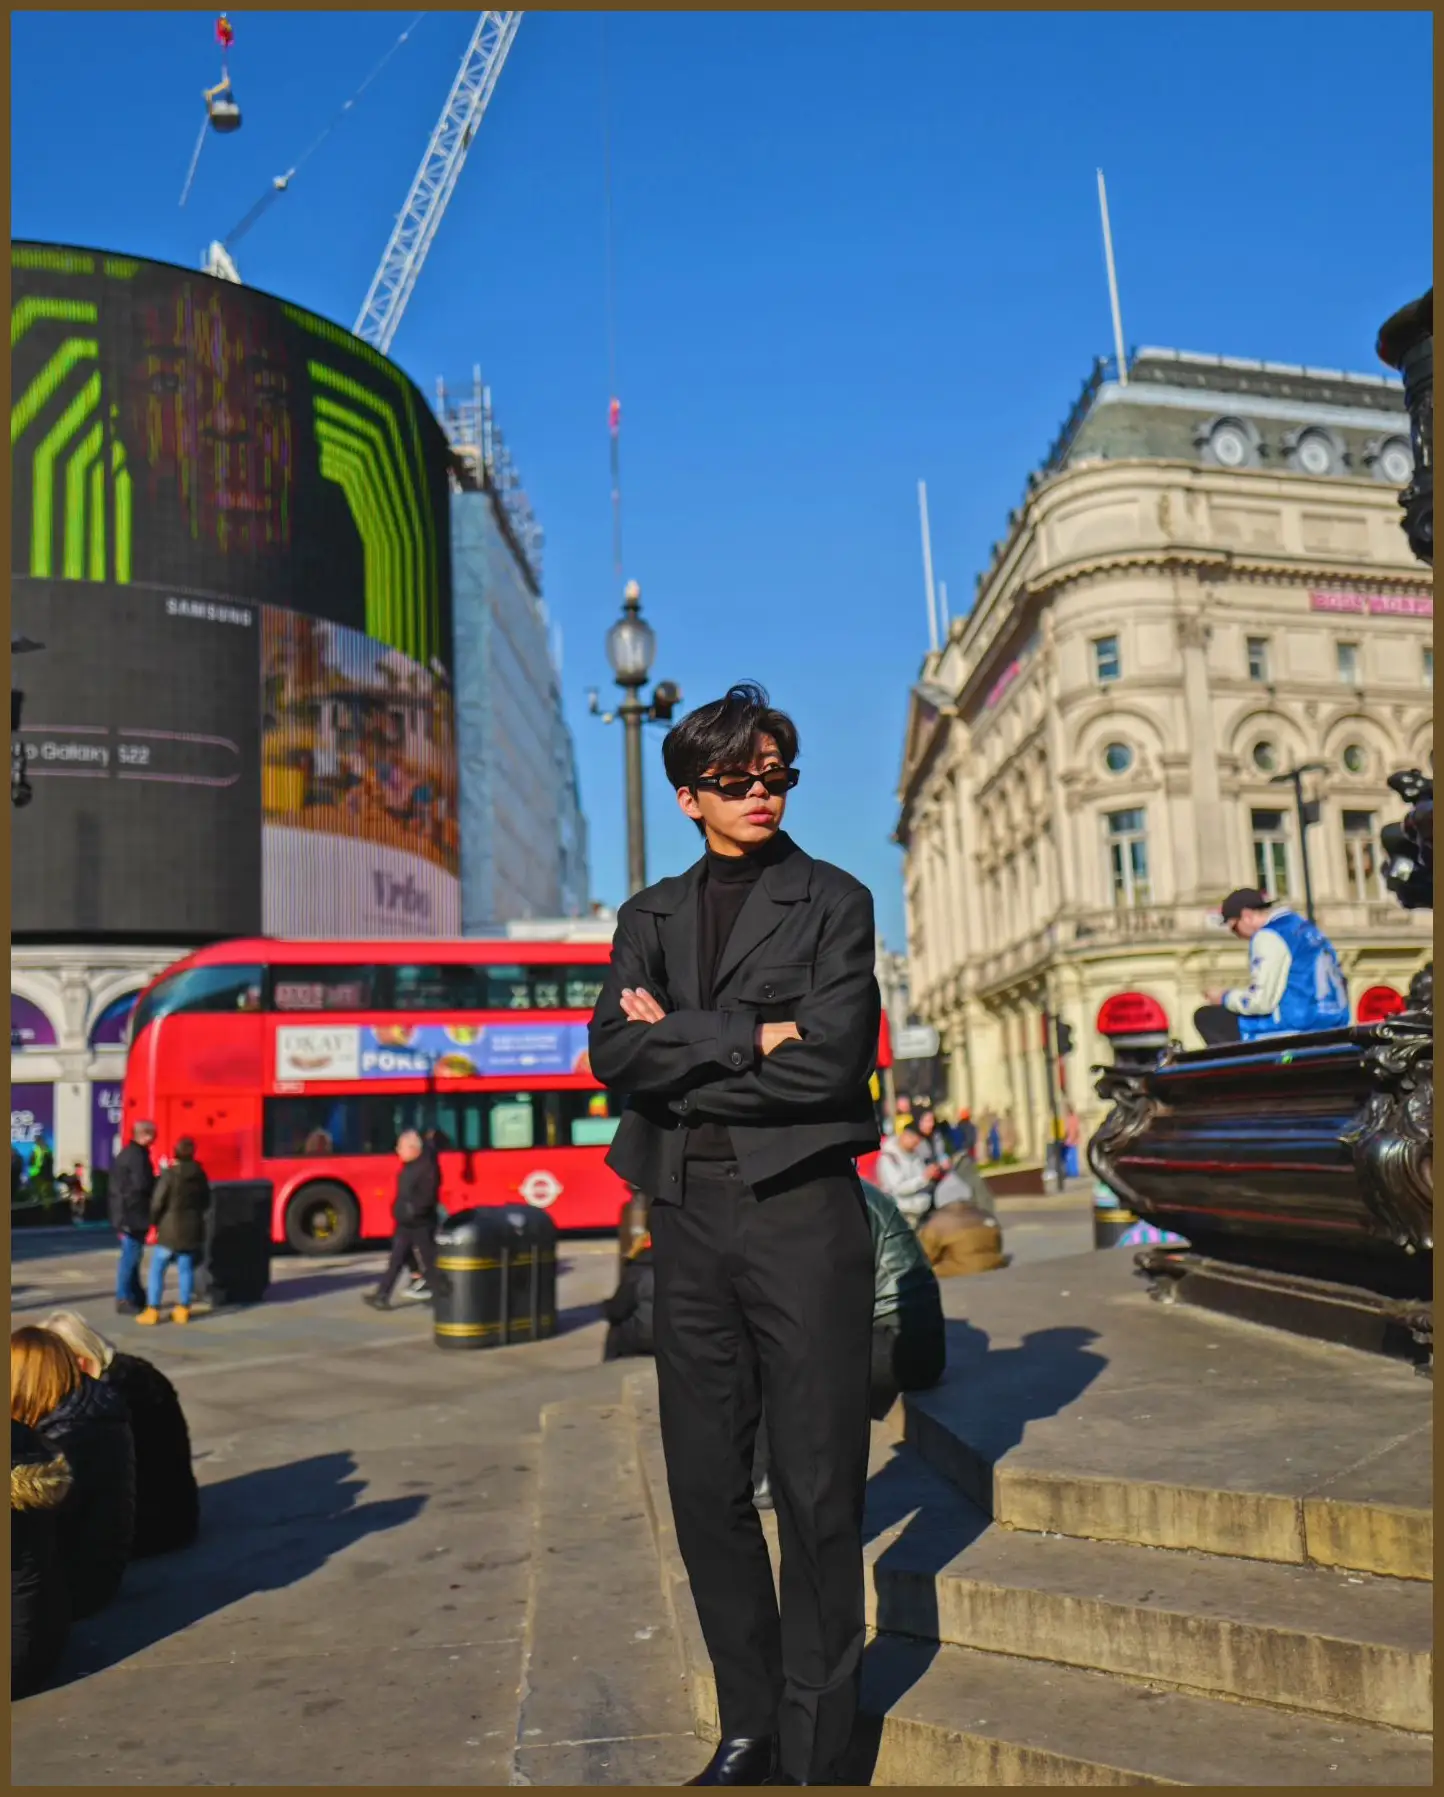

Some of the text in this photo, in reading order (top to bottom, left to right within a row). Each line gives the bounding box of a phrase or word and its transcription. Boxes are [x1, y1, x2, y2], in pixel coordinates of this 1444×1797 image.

[165, 597, 252, 627] SAMSUNG
[41, 741, 109, 768] Galaxy
[117, 743, 150, 765] S22
